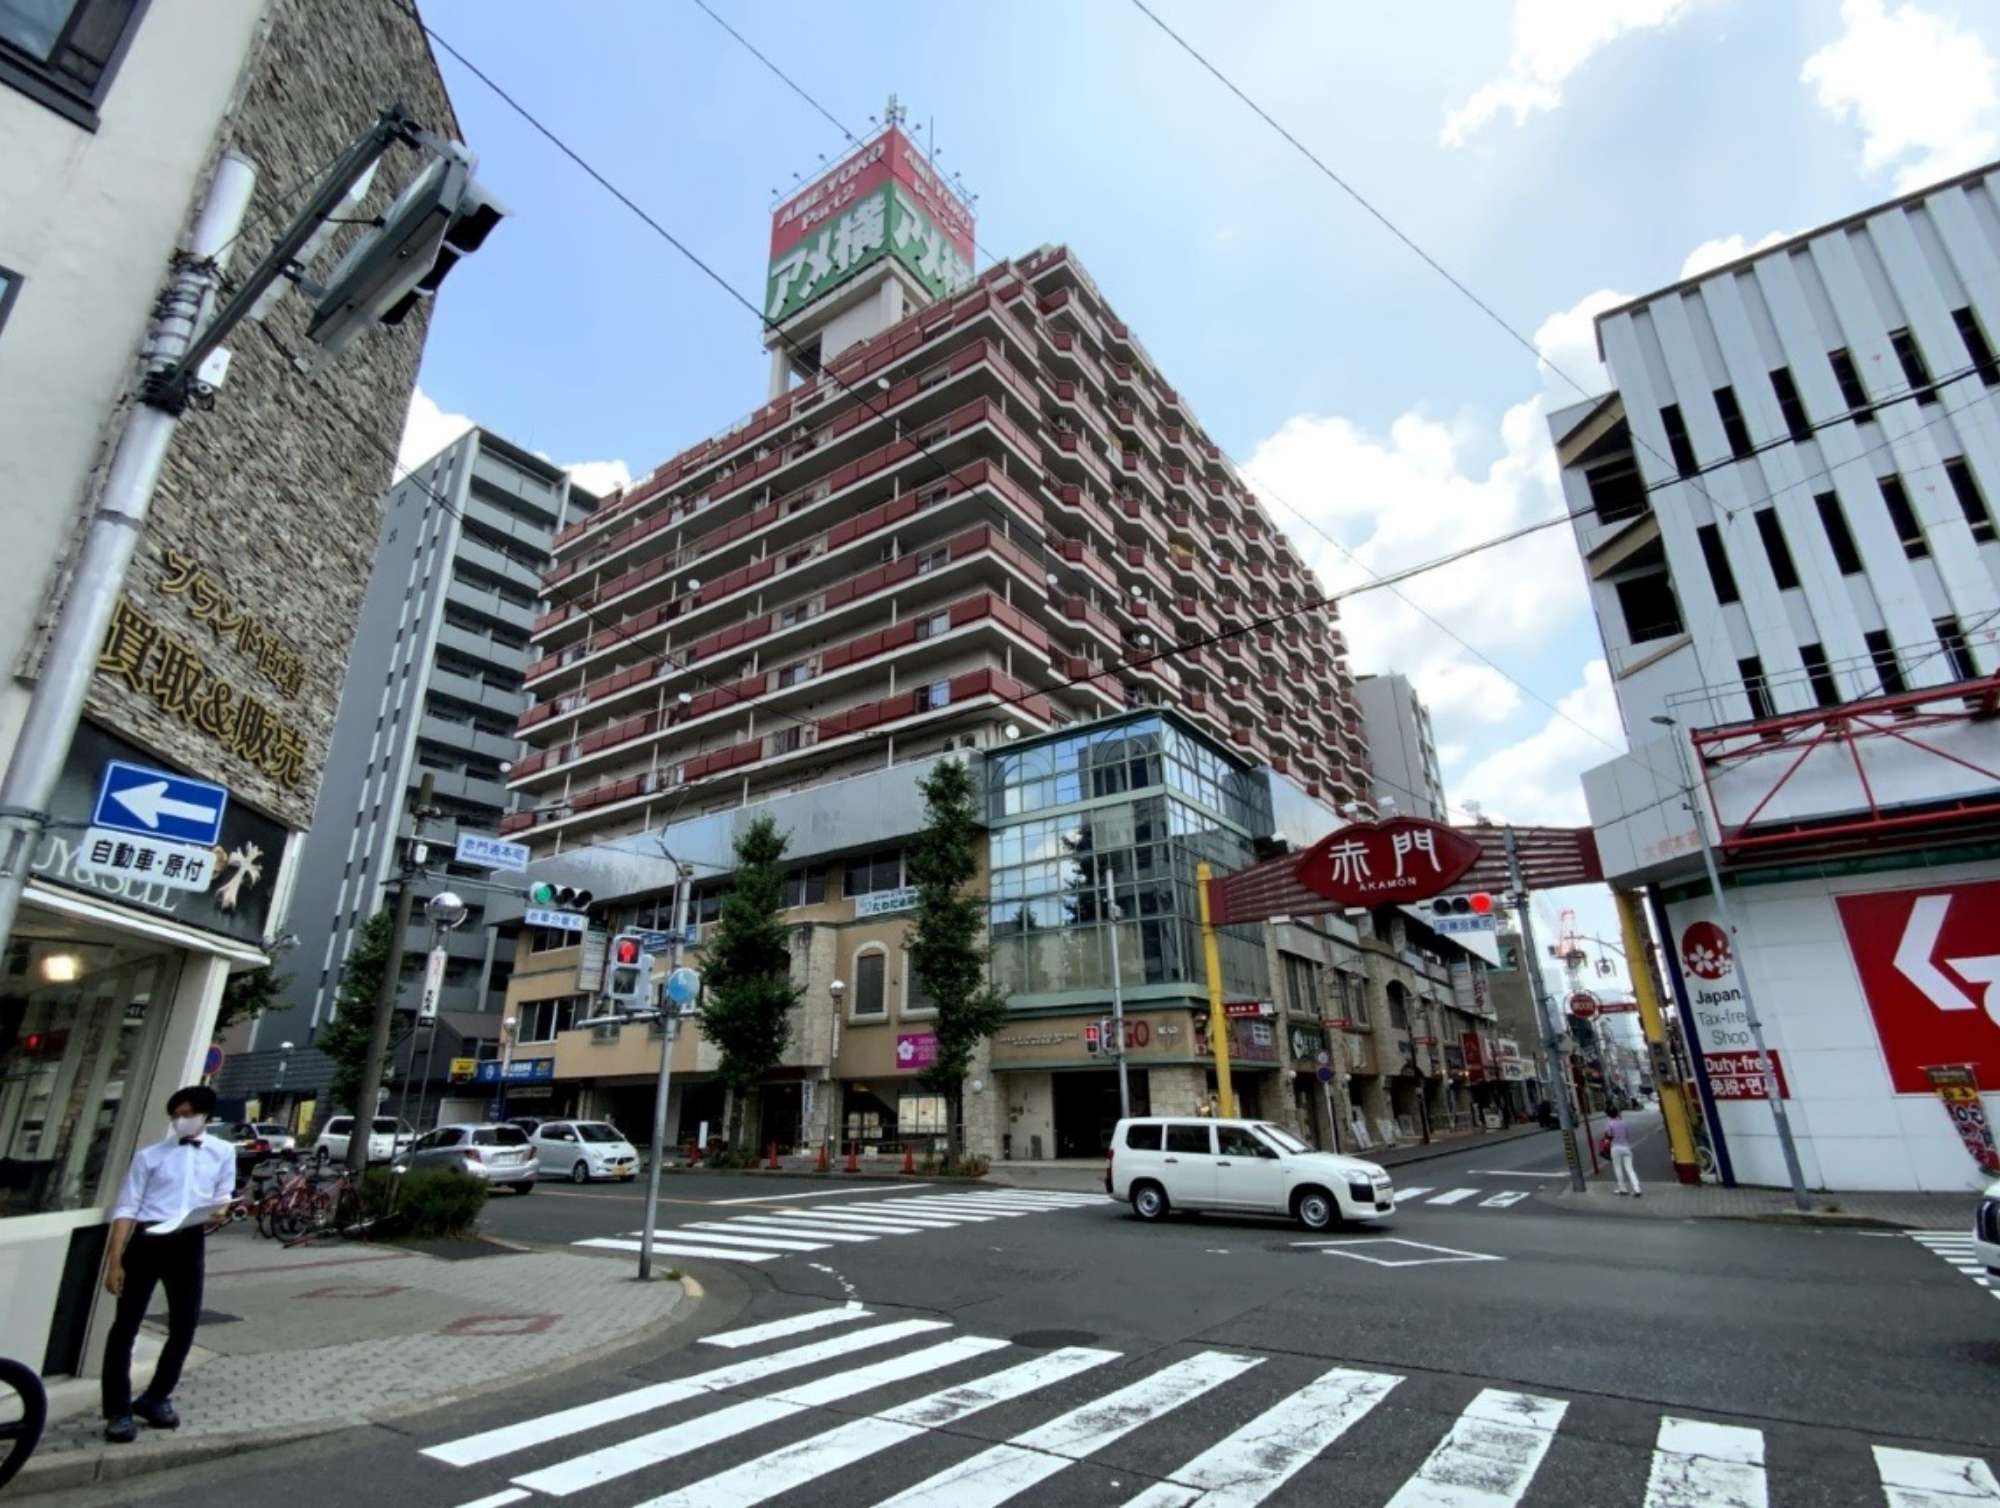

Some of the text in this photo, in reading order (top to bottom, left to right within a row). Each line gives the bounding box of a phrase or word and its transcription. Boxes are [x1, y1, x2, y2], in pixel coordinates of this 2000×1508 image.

[770, 191, 887, 319] アメ横
[161, 549, 304, 699] ブランド古着
[90, 839, 205, 884] 自動車・原付
[1328, 828, 1442, 885] 赤門
[1359, 876, 1417, 892] AKAMON
[1696, 988, 1742, 1006] Japan
[1695, 1008, 1748, 1026] Tax-fre
[1711, 1029, 1750, 1046] Shop
